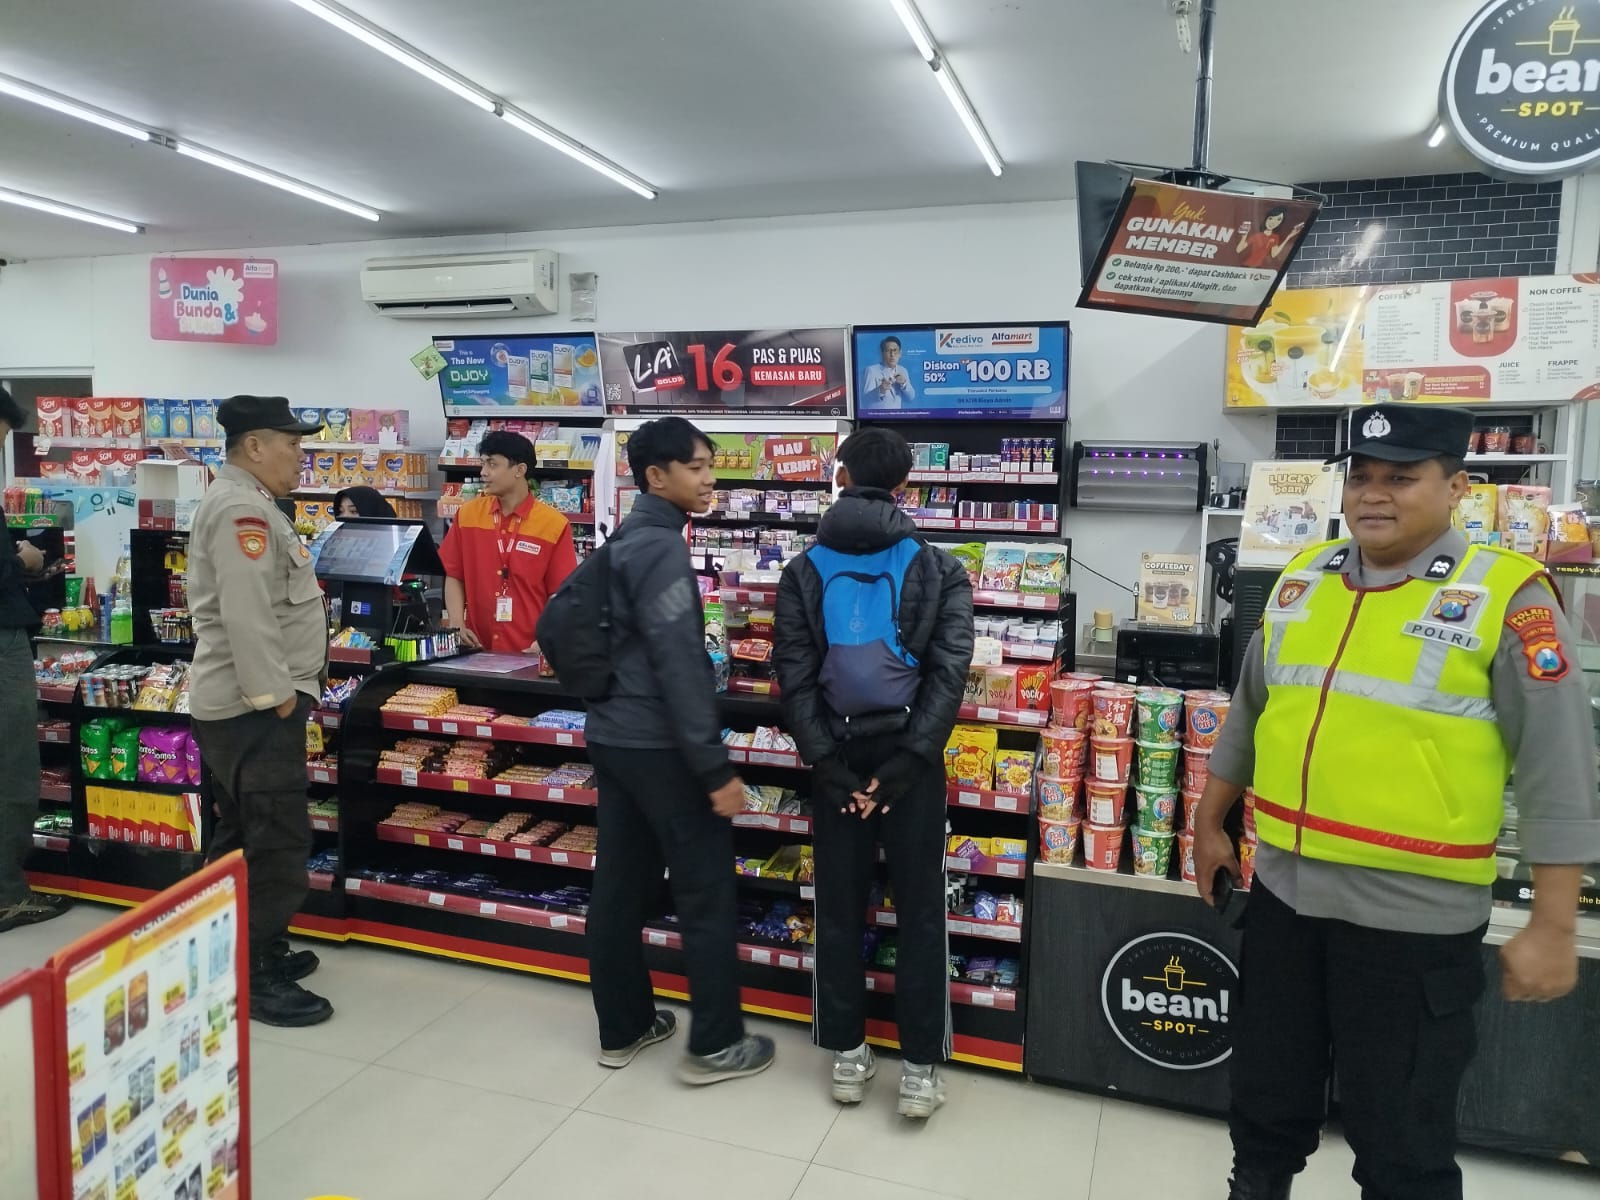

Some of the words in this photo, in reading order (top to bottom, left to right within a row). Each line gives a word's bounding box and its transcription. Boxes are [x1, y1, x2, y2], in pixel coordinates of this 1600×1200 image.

[1497, 0, 1544, 24] FRES
[1518, 101, 1584, 117] SPOT
[1480, 117, 1540, 151] PREMIUM
[1126, 216, 1234, 243] GUNAKAN
[1125, 235, 1218, 260] MEMBER
[1123, 260, 1153, 271] Belanja
[1155, 264, 1164, 273] Rp
[1188, 267, 1211, 278] dapat
[1212, 270, 1247, 280] Cashback
[1114, 281, 1151, 293] dapatkan
[1151, 285, 1194, 298] kejutannya
[1118, 273, 1132, 282] cek
[1133, 274, 1154, 284] struk
[1159, 277, 1190, 288] aplikasi
[1222, 284, 1237, 292] dan
[182, 285, 219, 301] Dunia
[1529, 287, 1548, 296] NON
[1550, 286, 1583, 295] COFFEE
[176, 301, 222, 318] Bunda
[224, 303, 236, 322] &
[939, 333, 983, 348] Kredivo
[992, 332, 1032, 341] Alfamart
[451, 357, 465, 365] The
[467, 357, 485, 365] New
[753, 349, 775, 364] PAS
[778, 349, 787, 363] &
[790, 347, 821, 363] PUAS
[1547, 359, 1579, 367] FRAPPE
[687, 343, 743, 392] 16
[924, 360, 960, 371] Diskon
[966, 359, 1012, 381] 100
[1016, 359, 1050, 380] RB
[754, 370, 795, 381] KEMASAN
[798, 369, 822, 381] BARU
[924, 372, 946, 383] 50%
[99, 451, 113, 461] SGM
[773, 442, 803, 456] MAU
[123, 453, 137, 462] SGM
[776, 458, 817, 475] LEBIH?
[1269, 473, 1318, 485] LUCKY
[1411, 623, 1472, 648] POLRI
[989, 688, 1013, 700] POCKY
[1020, 688, 1045, 701] POCKY
[1196, 712, 1210, 722] POP
[1579, 896, 1594, 904] the
[1121, 977, 1229, 1023] bean!
[1153, 1020, 1196, 1035] SPOT
